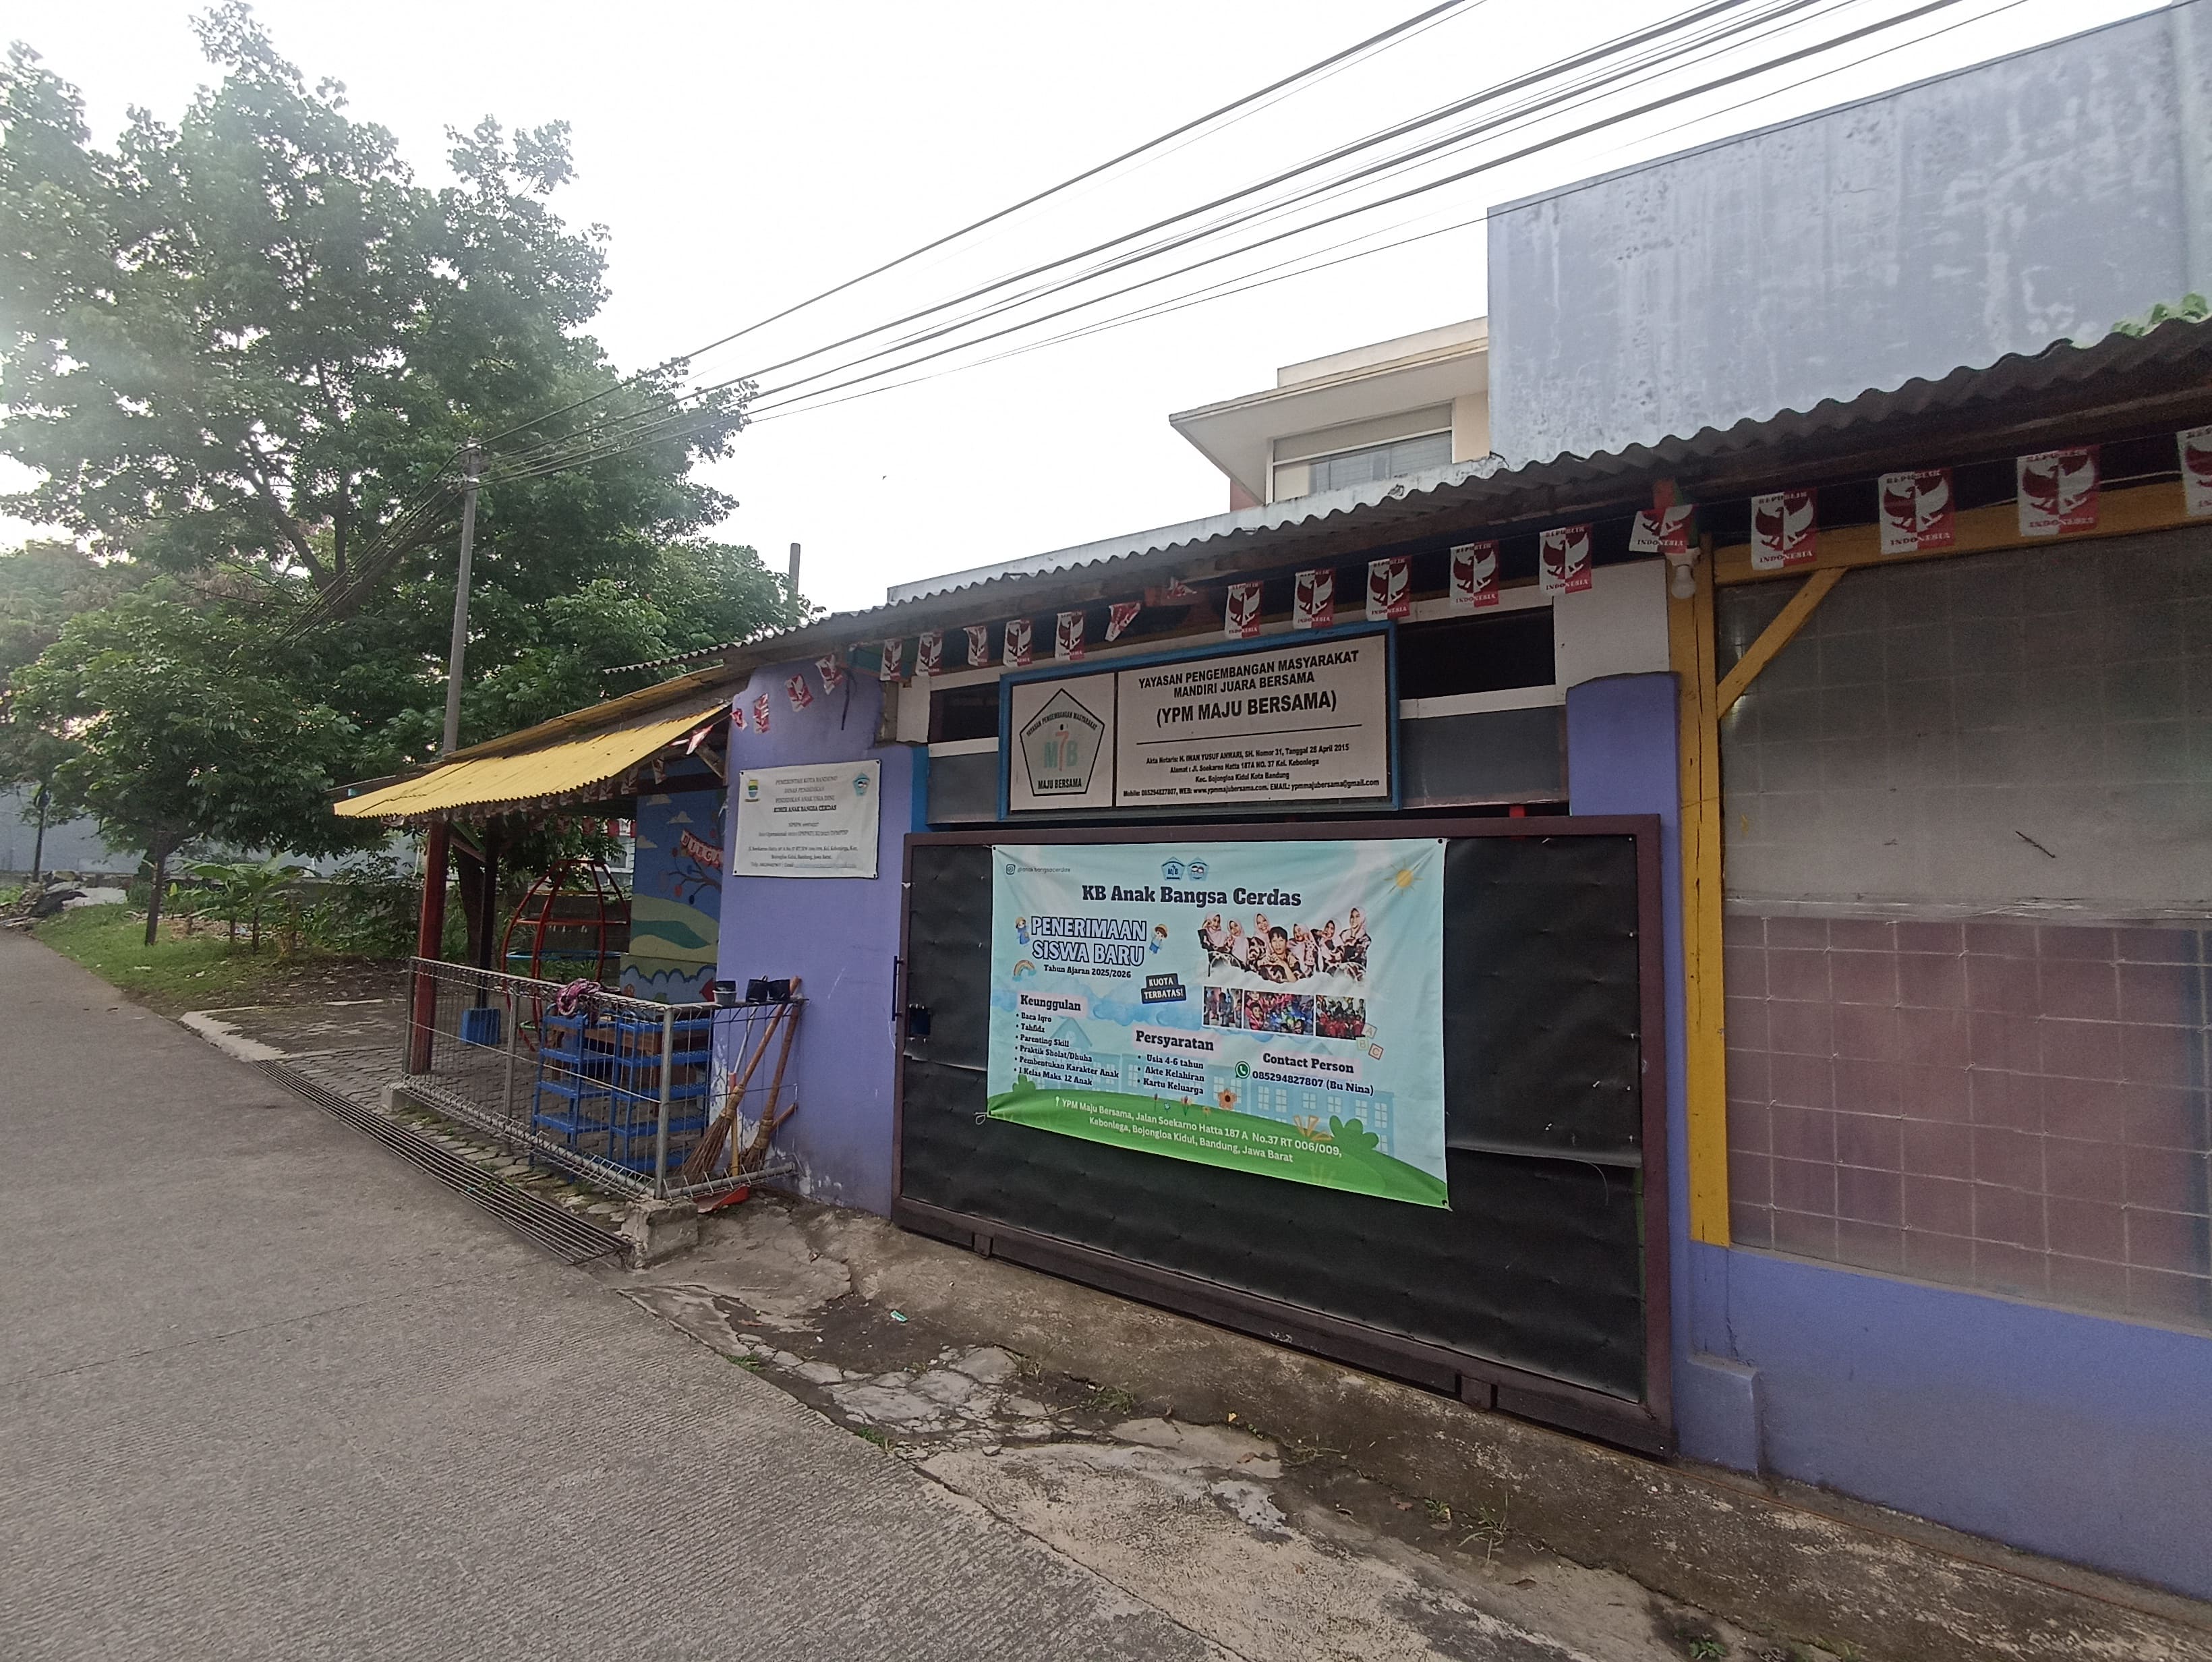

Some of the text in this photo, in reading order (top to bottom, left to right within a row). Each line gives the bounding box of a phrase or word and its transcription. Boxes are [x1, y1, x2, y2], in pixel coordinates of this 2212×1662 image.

[1759, 550, 1813, 563] INDONESIA
[1546, 579, 1589, 591] INDONESIA
[1455, 594, 1496, 604] INDONESIA
[1371, 606, 1407, 615] INDONESIA
[1298, 616, 1331, 624] INDONESIA
[1138, 650, 1359, 689] YAYASAN PENGEMBANGAN MASYARAKAT
[1173, 671, 1315, 698] MANDIRI JUARA BERSAMA
[1157, 690, 1337, 728] (YPM MAJU BERSAMA)
[1285, 747, 1308, 755] Tanggal
[1318, 744, 1333, 754] April
[1334, 743, 1349, 751] 2015
[1199, 764, 1224, 772] Soekarno
[1264, 772, 1289, 780] Bandung
[1038, 778, 1082, 789] MAJU BERSAMA
[1082, 885, 1302, 908] KB Anak Bangsa Cerdas
[1031, 915, 1147, 942] PENERIMAAN
[1032, 940, 1144, 967] SISWA BARU
[1043, 964, 1132, 978] Tahun Ajaran 2025/2026
[1148, 978, 1174, 987] KUOTA
[1020, 994, 1082, 1012] Keunggulan
[1144, 990, 1184, 1000] TERBATAS!
[1021, 1012, 1052, 1023] Baca Iqro
[1021, 1023, 1045, 1033] Tahfidz
[1020, 1034, 1070, 1048] Parenting Skill
[1135, 1030, 1215, 1052] Persyaratan
[1020, 1045, 1093, 1062] Praktik Sholat/Dhuha
[1146, 1054, 1204, 1069] Usia 4-6 tahun
[1019, 1056, 1119, 1078] Pembentukan Karakter Anak
[1262, 1052, 1355, 1074] Contact Person
[1023, 1067, 1041, 1077] Kelas
[1064, 1074, 1072, 1083] 12
[1073, 1077, 1093, 1086] Anak
[1144, 1065, 1205, 1083] Akte Kelahiran
[1142, 1078, 1204, 1095] Kartu Keluarga
[1252, 1070, 1374, 1097] 085294827807 (Bu Nina)
[1061, 1099, 1343, 1158] YPM Maju Bersama, Jalan Soekarno Hatta 187 A No.37 RT 006/009,
[1089, 1116, 1293, 1163] Kebonlega, Bojongloa Kidul, Bandung, Jawa Barat
